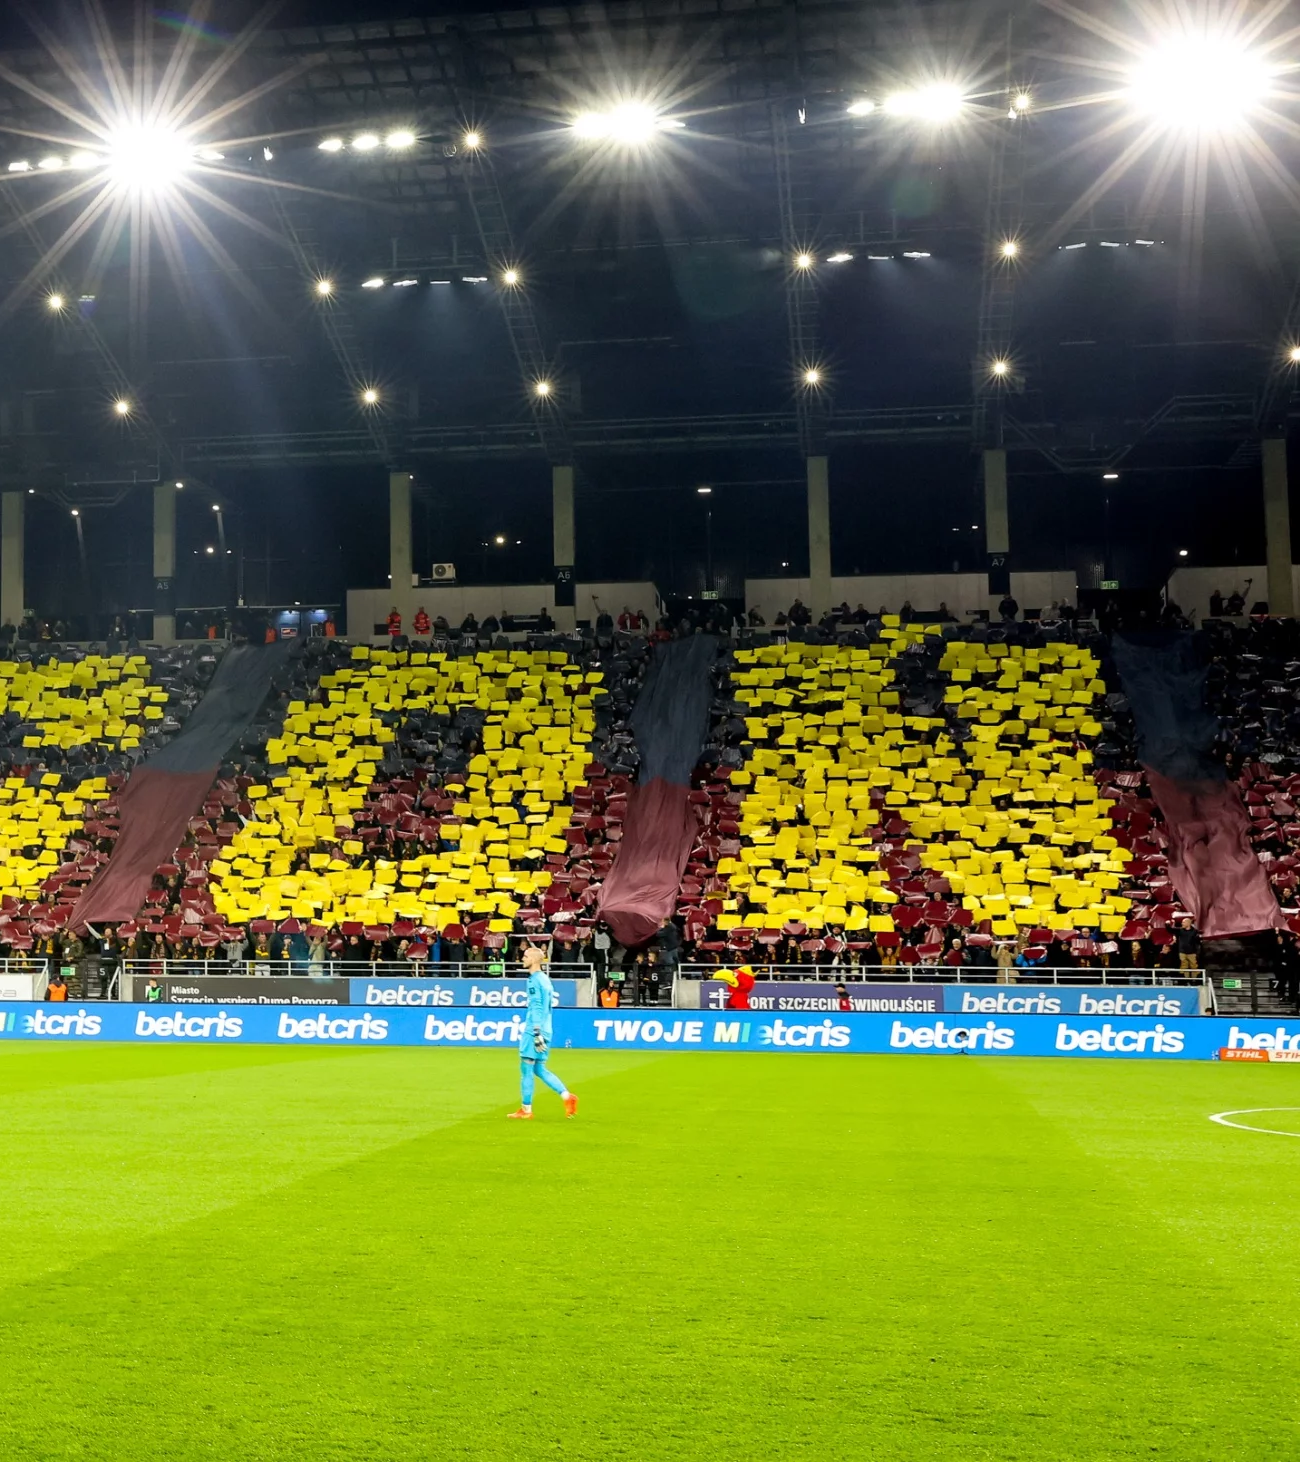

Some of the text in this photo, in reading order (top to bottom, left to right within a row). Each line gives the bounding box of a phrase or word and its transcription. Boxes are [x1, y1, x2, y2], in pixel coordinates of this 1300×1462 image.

[992, 557, 1005, 567] A7
[156, 581, 169, 590] A5
[557, 571, 571, 580] A6
[651, 972, 659, 982] 6
[1271, 980, 1280, 989] 7
[171, 986, 200, 995] Miasto
[365, 984, 455, 1006] betcris
[469, 985, 560, 1008] betcs
[746, 996, 776, 1010] ORT
[778, 997, 840, 1011] SZCZECIN
[961, 992, 1062, 1014] betcris
[1079, 994, 1181, 1015] betcris
[134, 1010, 244, 1038] betcris
[277, 1012, 389, 1040] betcris
[593, 1019, 704, 1043] TWOJE
[890, 1020, 1016, 1050] betcris
[1055, 1023, 1185, 1053] betcris
[1225, 1050, 1264, 1059] STIHL
